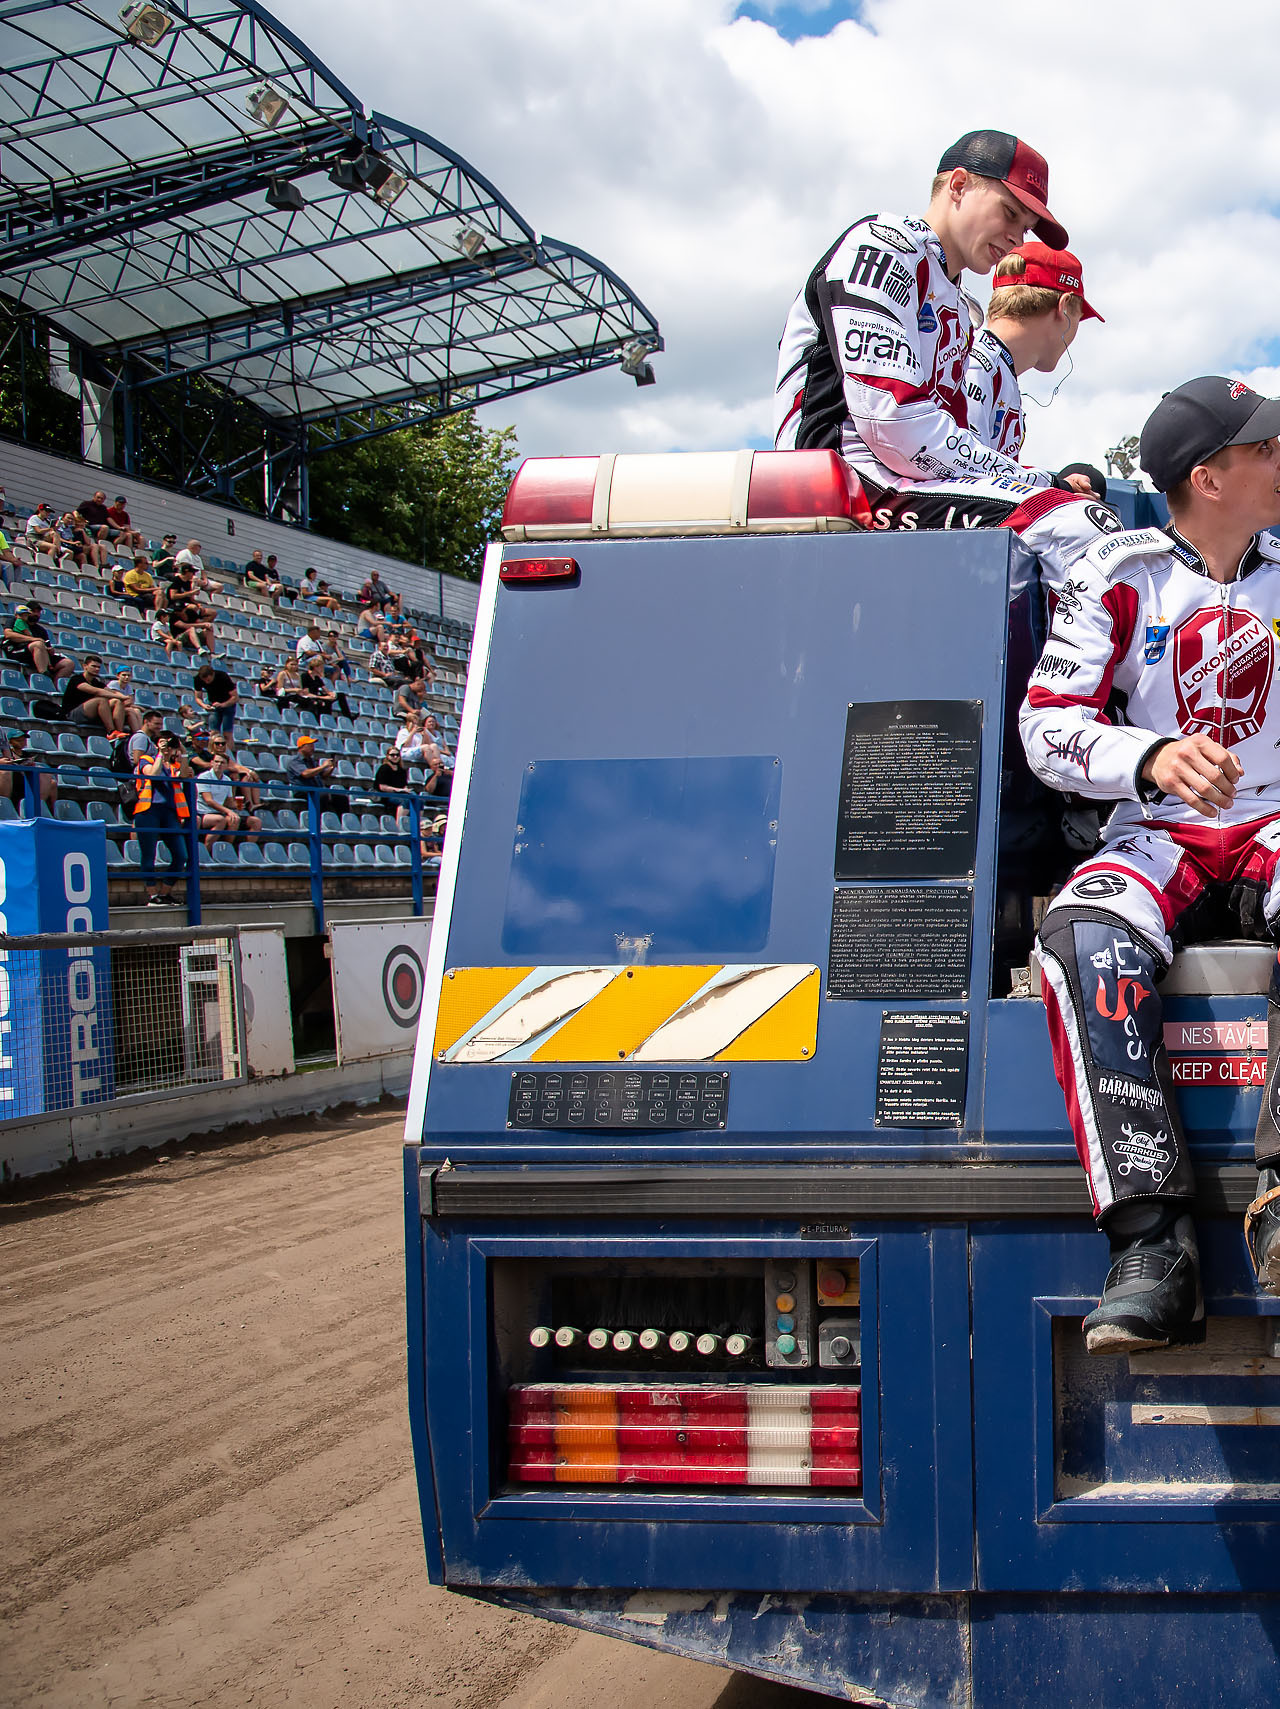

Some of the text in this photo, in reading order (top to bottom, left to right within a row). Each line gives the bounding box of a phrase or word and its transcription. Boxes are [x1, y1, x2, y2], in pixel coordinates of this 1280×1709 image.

[1058, 273, 1080, 288] #56
[1182, 623, 1261, 691] LOKOMOTIV
[1228, 640, 1269, 675] DAUGAVPILS
[63, 852, 102, 1107] TRODO
[1172, 1062, 1212, 1081] KEEP
[1111, 1095, 1155, 1112] FAMILY
[1118, 1143, 1164, 1160] MARKUS
